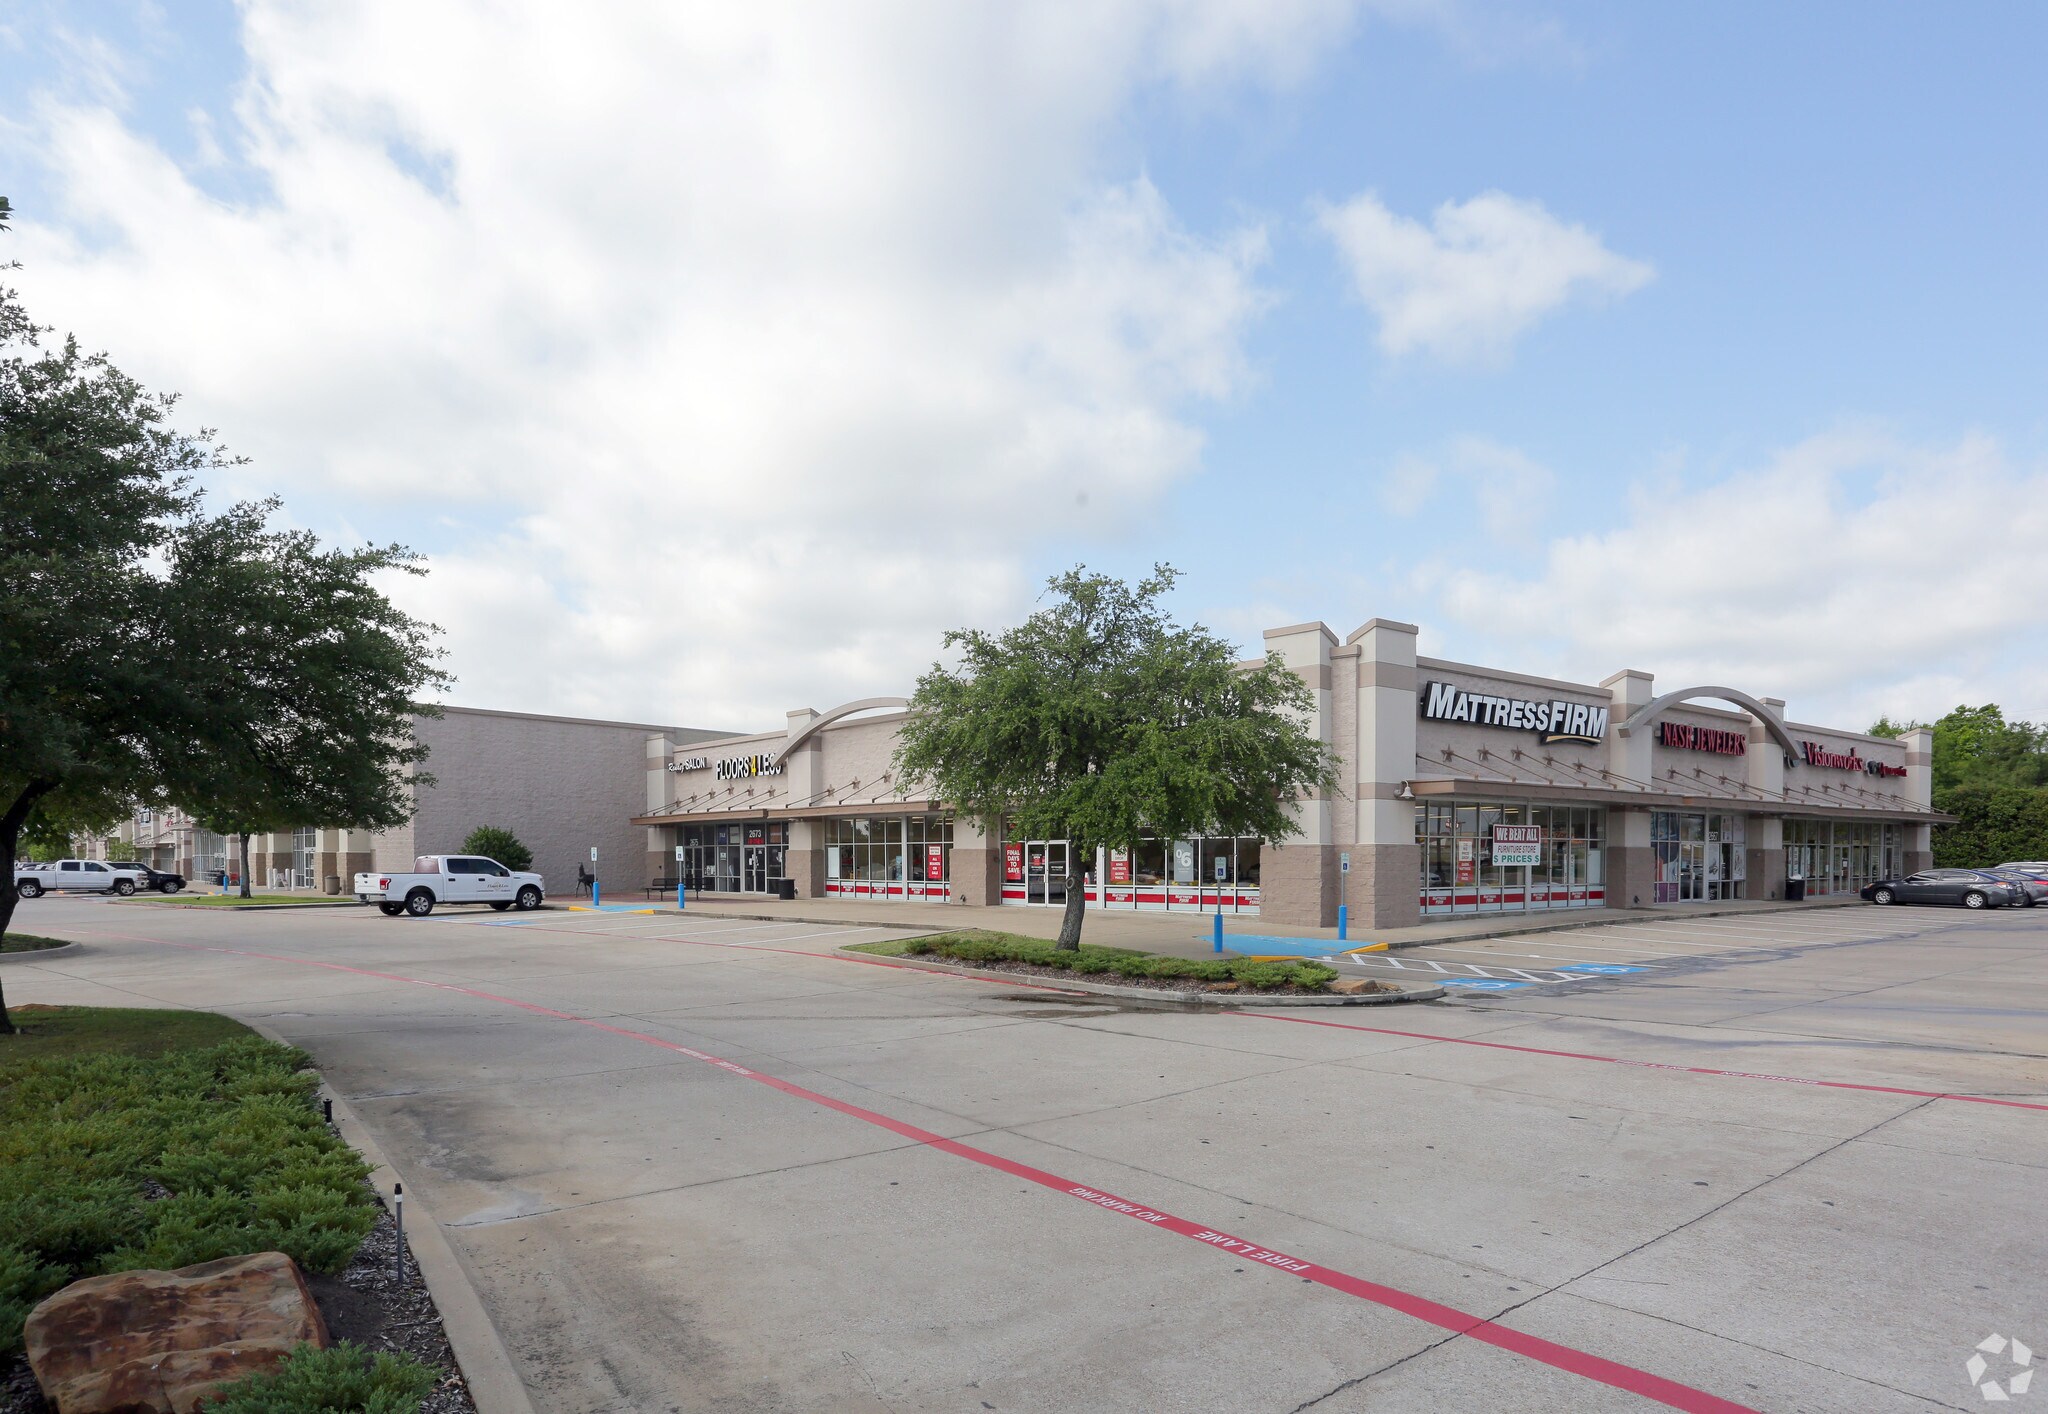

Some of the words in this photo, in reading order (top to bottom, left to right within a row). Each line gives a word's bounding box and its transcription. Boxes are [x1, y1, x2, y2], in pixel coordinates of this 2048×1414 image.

[1663, 721, 1693, 749] NASR
[1694, 727, 1747, 757] JEWELERS
[685, 757, 706, 770] SALON
[716, 756, 750, 780] FLOORS
[751, 755, 757, 777] 4
[1496, 827, 1508, 841] WE
[1508, 828, 1526, 841] BEAT
[1526, 828, 1538, 841] ALL
[1497, 845, 1522, 853] FURNITURE
[1522, 845, 1537, 853] STORE
[1501, 855, 1533, 863] PRICES
[1069, 1187, 1136, 1213] PARKING
[1136, 1211, 1167, 1222] NO
[1193, 1231, 1256, 1253] LANE
[1250, 1250, 1310, 1271] FIRE
